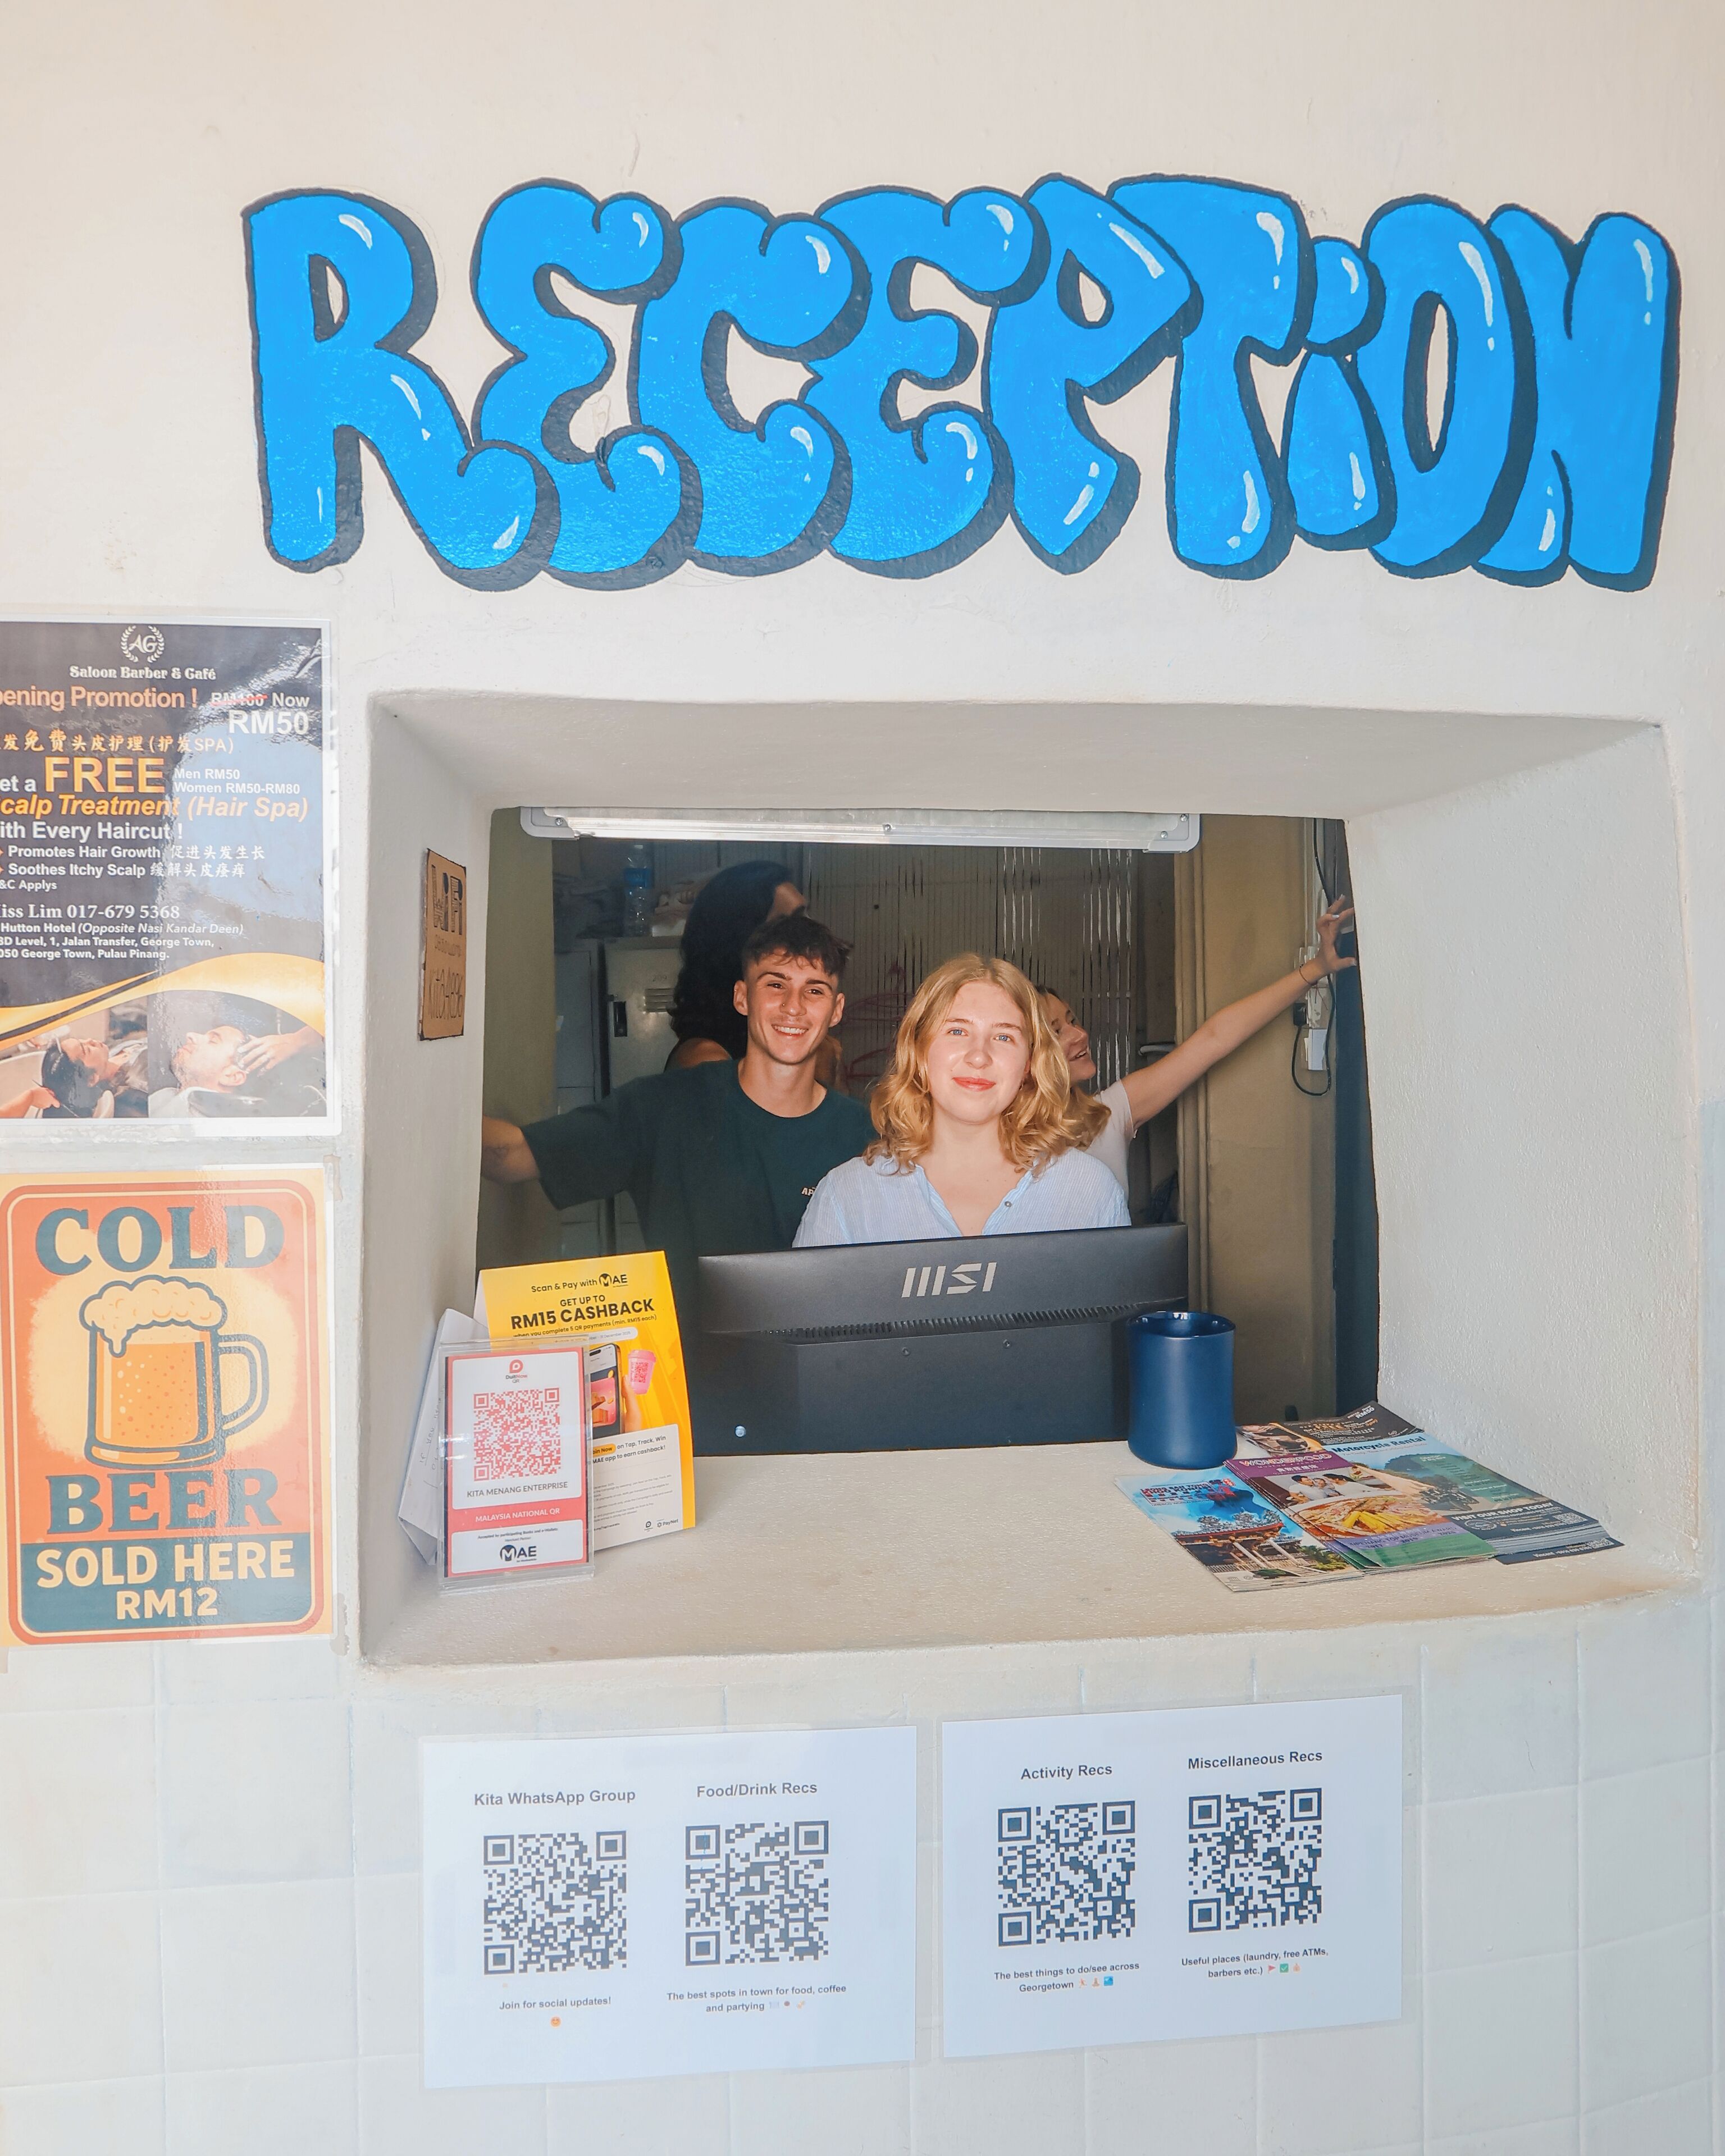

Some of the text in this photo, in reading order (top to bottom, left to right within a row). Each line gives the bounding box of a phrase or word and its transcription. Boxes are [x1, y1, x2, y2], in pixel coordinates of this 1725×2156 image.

[129, 635, 158, 653] AG
[69, 666, 216, 680] Saloon Barber & Café
[0, 685, 65, 712] ening
[71, 686, 185, 708] Promotion
[211, 692, 309, 707] RM100 Now
[229, 710, 309, 735] RM50
[45, 756, 165, 793] FREE
[174, 768, 240, 780] Men RM50
[24, 778, 36, 792] a
[174, 782, 300, 794] Women RM50-RM80
[58, 794, 180, 816] Treatment
[188, 796, 247, 821] (Hair
[254, 797, 308, 821] Spa)
[32, 821, 91, 843] Every
[97, 821, 171, 839] Haircut
[8, 844, 266, 861] Promotes Hair Growth 促进头发生长
[8, 862, 245, 878] Soothes Itchy Scalp 缓解头皮瘙痒
[19, 879, 57, 892] Applys
[0, 903, 180, 919] iss Lim 017-679 5368
[1, 922, 244, 935] Hutton Hotel (Opposite Nasi Kandar Deen)
[15, 937, 215, 948] Level, 1, Jalan Transfer, George Town,
[21, 949, 170, 961] George Town, Pulau Pinang.
[35, 1205, 285, 1276] COLD
[531, 1284, 553, 1292] Scan
[563, 1281, 578, 1290] Pay
[580, 1278, 597, 1287] with
[599, 1273, 628, 1287] MAE
[901, 1262, 997, 1298] MSI
[560, 1295, 605, 1307] GET UP TO
[511, 1298, 655, 1330] RM15 CASHBACK
[542, 1327, 569, 1336] complete
[583, 1321, 611, 1331] payments
[612, 1318, 627, 1326] (min.
[641, 1314, 657, 1322] each)
[637, 1445, 666, 1455] cashback!
[1331, 1441, 1390, 1454] Motorcycle
[1391, 1436, 1427, 1447] Rental
[486, 1486, 521, 1496] MENANG
[523, 1481, 568, 1492] ENTERPRISE
[45, 1468, 282, 1534] BEER
[1498, 1506, 1523, 1516] SHOP
[1523, 1502, 1554, 1512] TODAY
[475, 1513, 510, 1522] MALAYSIA
[512, 1509, 548, 1518] NATIONAL
[662, 1518, 679, 1527] PayNet
[499, 1545, 537, 1562] MAE
[36, 1541, 295, 1588] SOLD HERE
[116, 1587, 219, 1620] RM12
[1188, 1750, 1323, 1770] Miscellaneous Recs
[1021, 1764, 1113, 1780] Activity Recs
[474, 1790, 636, 1806] Kita WhatsApp Group
[696, 1782, 818, 1798] Food/Drink Recs
[1181, 1948, 1329, 1966] Useful places (laundry, free ATMs,
[994, 1971, 1011, 1981] The
[1014, 1970, 1033, 1979] best
[1035, 1967, 1064, 1979] things
[1078, 1964, 1107, 1975] do/see
[1110, 1962, 1140, 1972] across
[1208, 1966, 1263, 1978] barbers etc.)
[667, 1992, 684, 2001] The
[687, 1991, 707, 2000] best
[709, 1989, 736, 2000] spots
[750, 1988, 773, 1996] town
[775, 1986, 790, 1995] for
[791, 1985, 815, 1995] food,
[818, 1984, 847, 1993] coffee
[1019, 1981, 1074, 1993] Georgetown
[499, 1997, 612, 2010] Join for social updates!
[705, 2002, 765, 2013] and partying
